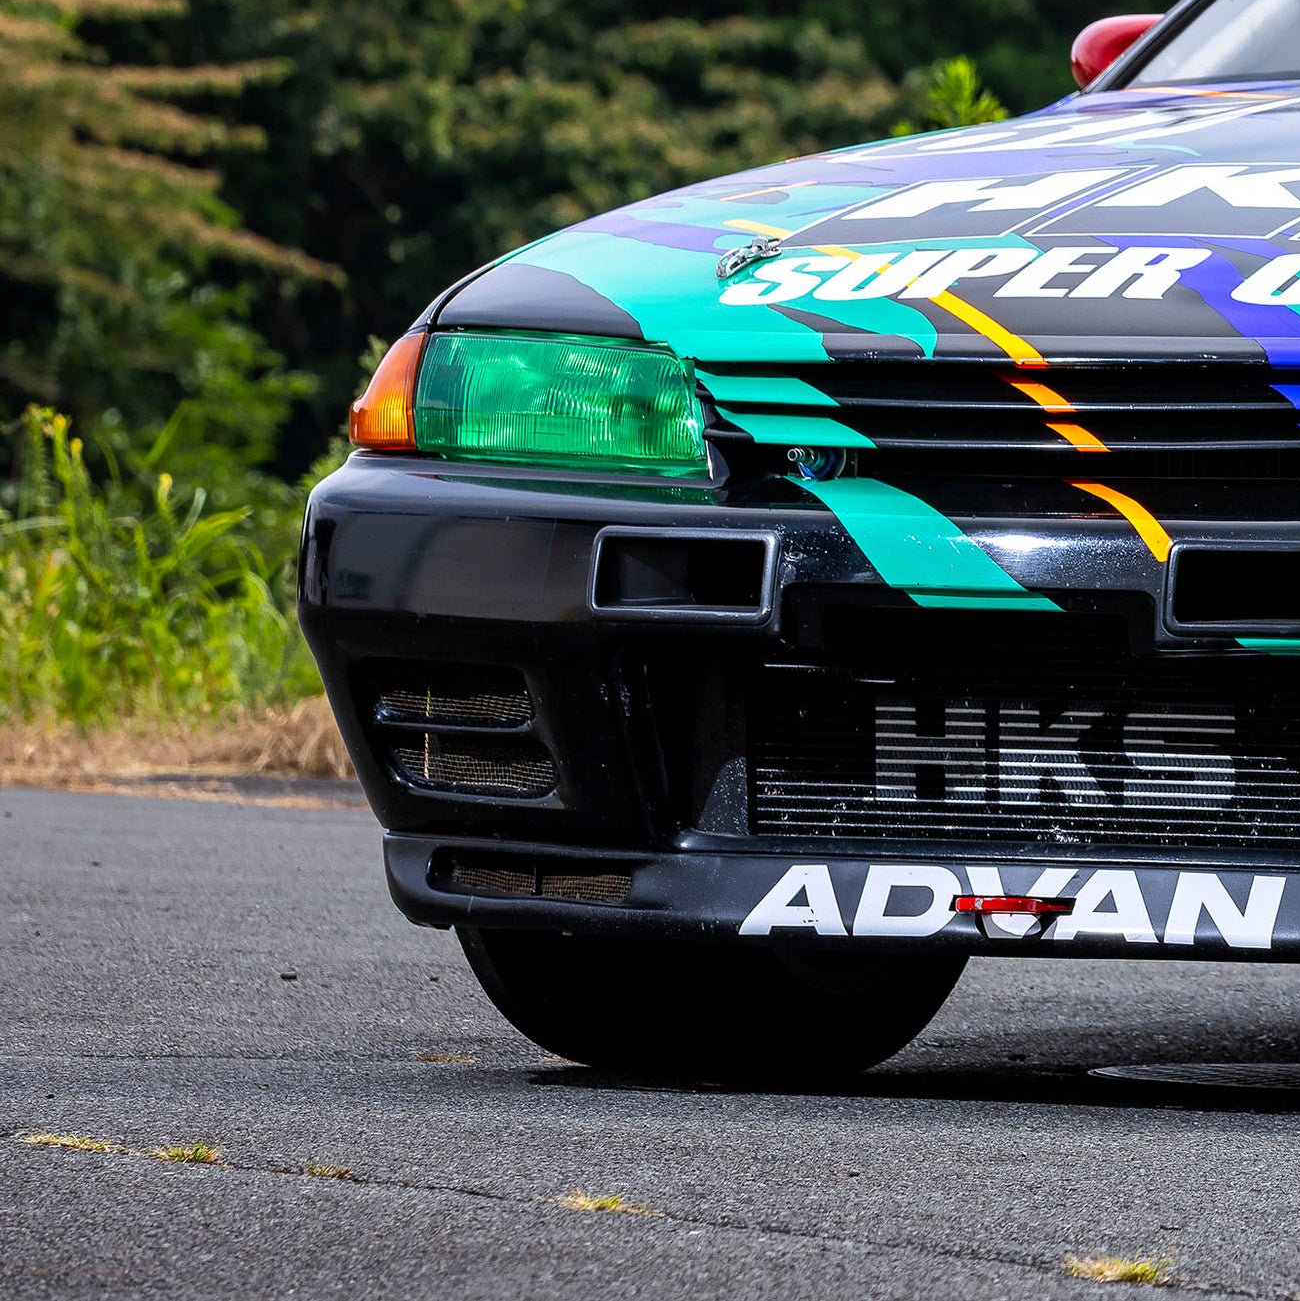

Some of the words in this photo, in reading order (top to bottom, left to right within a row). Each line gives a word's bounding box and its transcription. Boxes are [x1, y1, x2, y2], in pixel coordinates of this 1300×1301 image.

[718, 246, 1213, 306] SUPER
[875, 698, 1237, 810] HKS
[738, 863, 1287, 950] ADVAN
